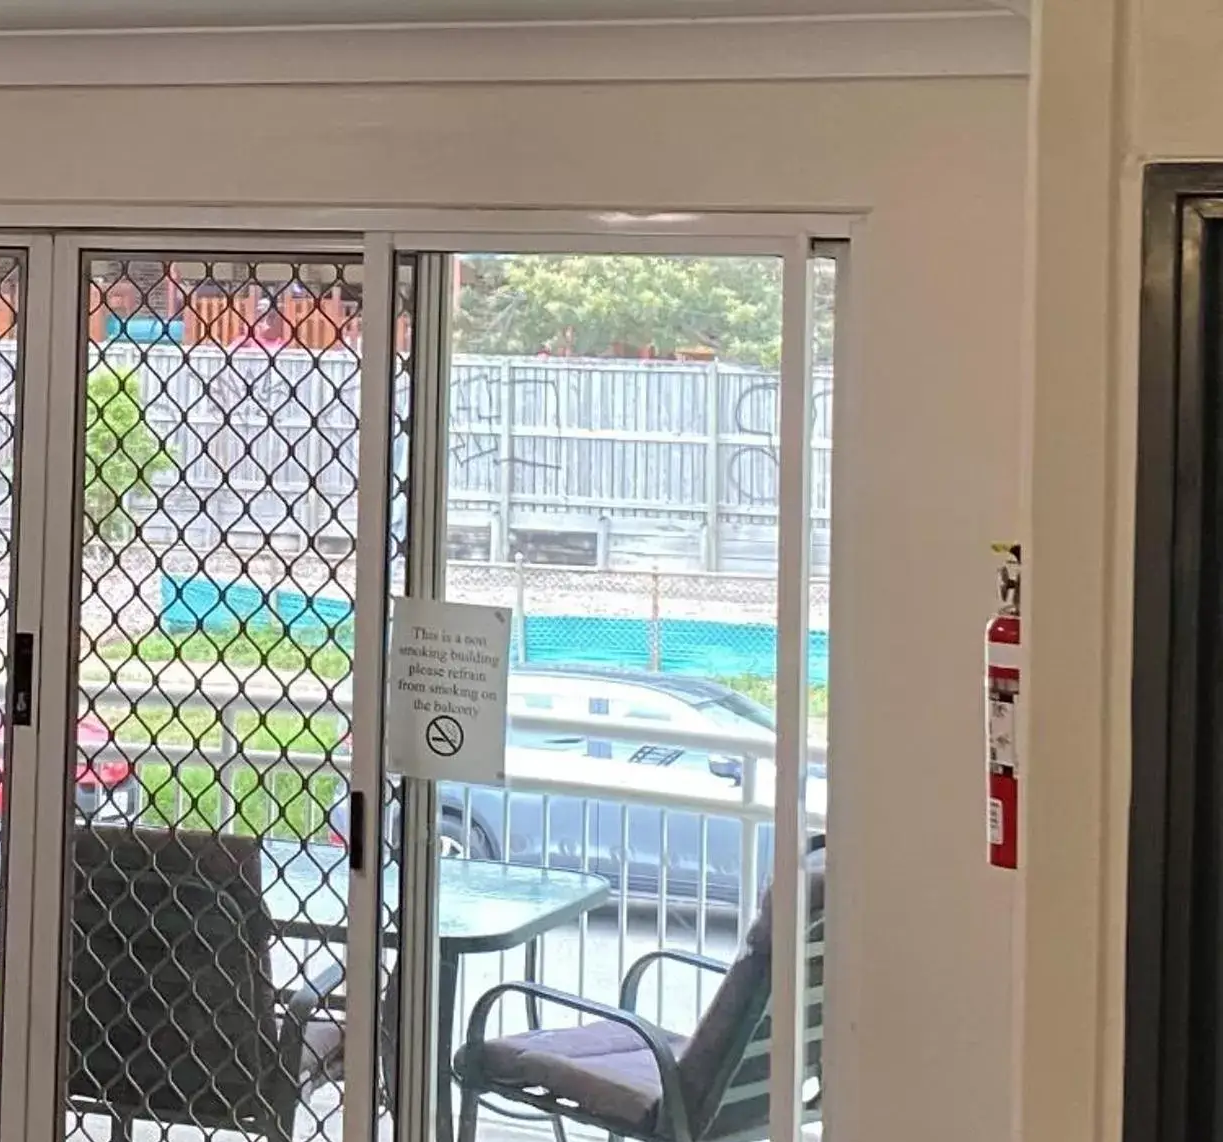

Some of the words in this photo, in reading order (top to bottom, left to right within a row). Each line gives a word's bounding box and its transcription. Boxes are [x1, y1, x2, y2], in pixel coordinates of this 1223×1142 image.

[412, 626, 438, 641] This
[442, 629, 451, 643] is
[455, 635, 461, 643] a
[465, 635, 487, 646] non
[399, 645, 447, 663] smoking
[451, 650, 500, 668] building
[408, 662, 445, 677] please
[448, 666, 486, 681] refrain
[398, 678, 425, 692] from
[429, 683, 478, 701] smoking
[481, 691, 497, 701] on
[414, 698, 431, 711] the
